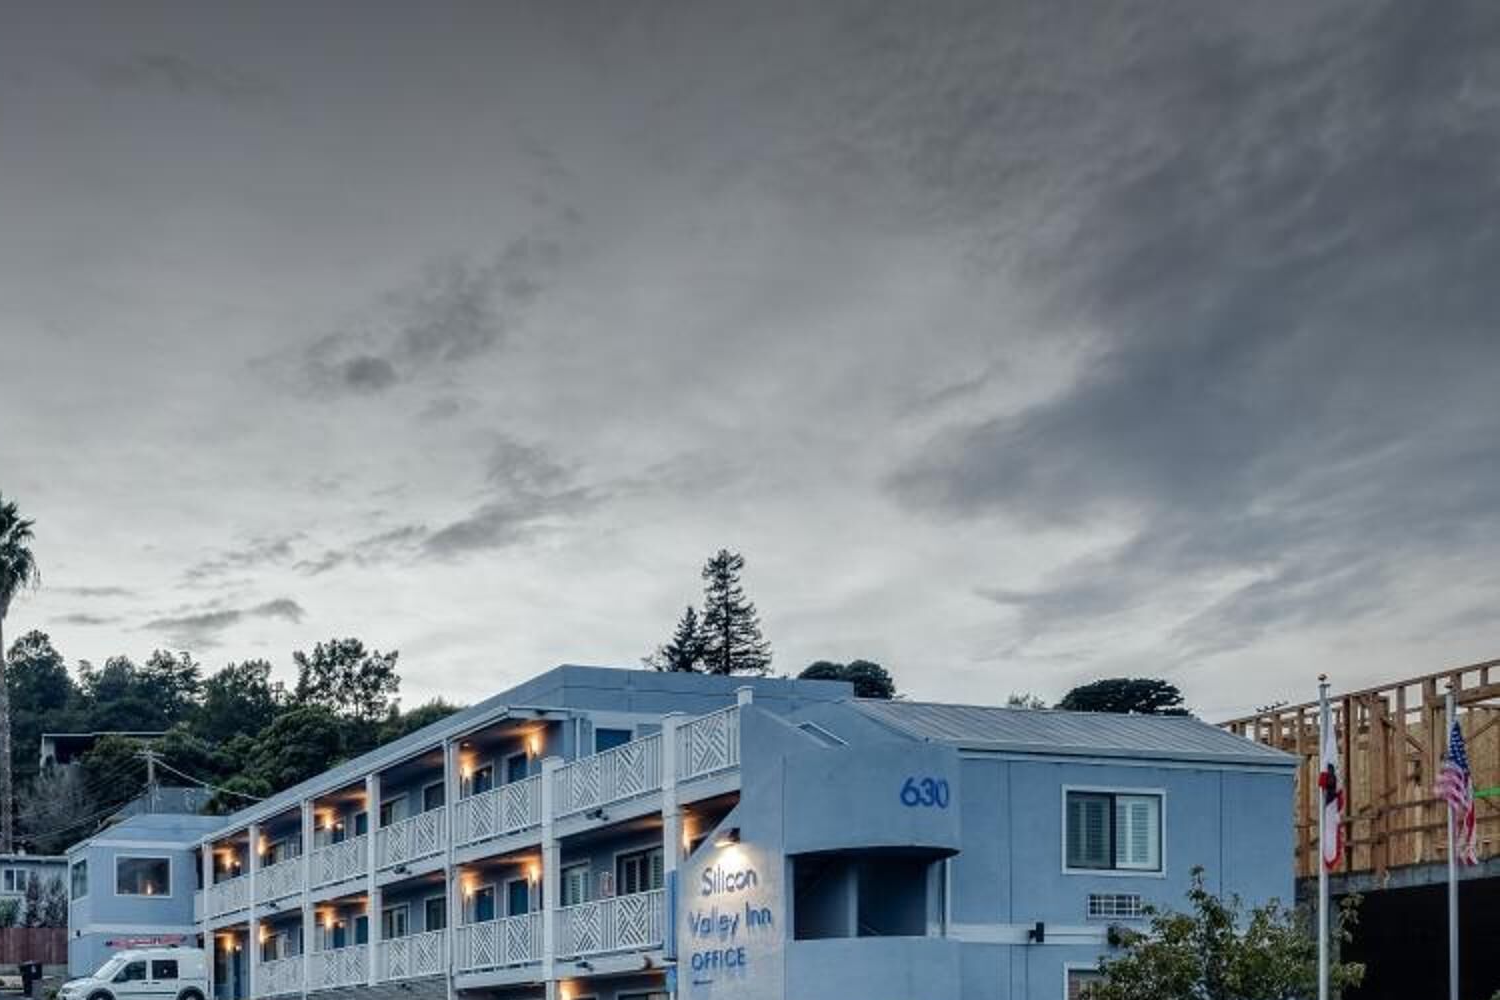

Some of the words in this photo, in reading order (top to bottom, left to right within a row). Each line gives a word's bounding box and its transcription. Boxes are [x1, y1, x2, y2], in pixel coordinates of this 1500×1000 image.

[900, 776, 949, 809] 630
[701, 864, 758, 896] Silicon
[689, 903, 740, 938] Valley
[745, 901, 772, 928] Inn
[691, 947, 747, 971] OFFICE
